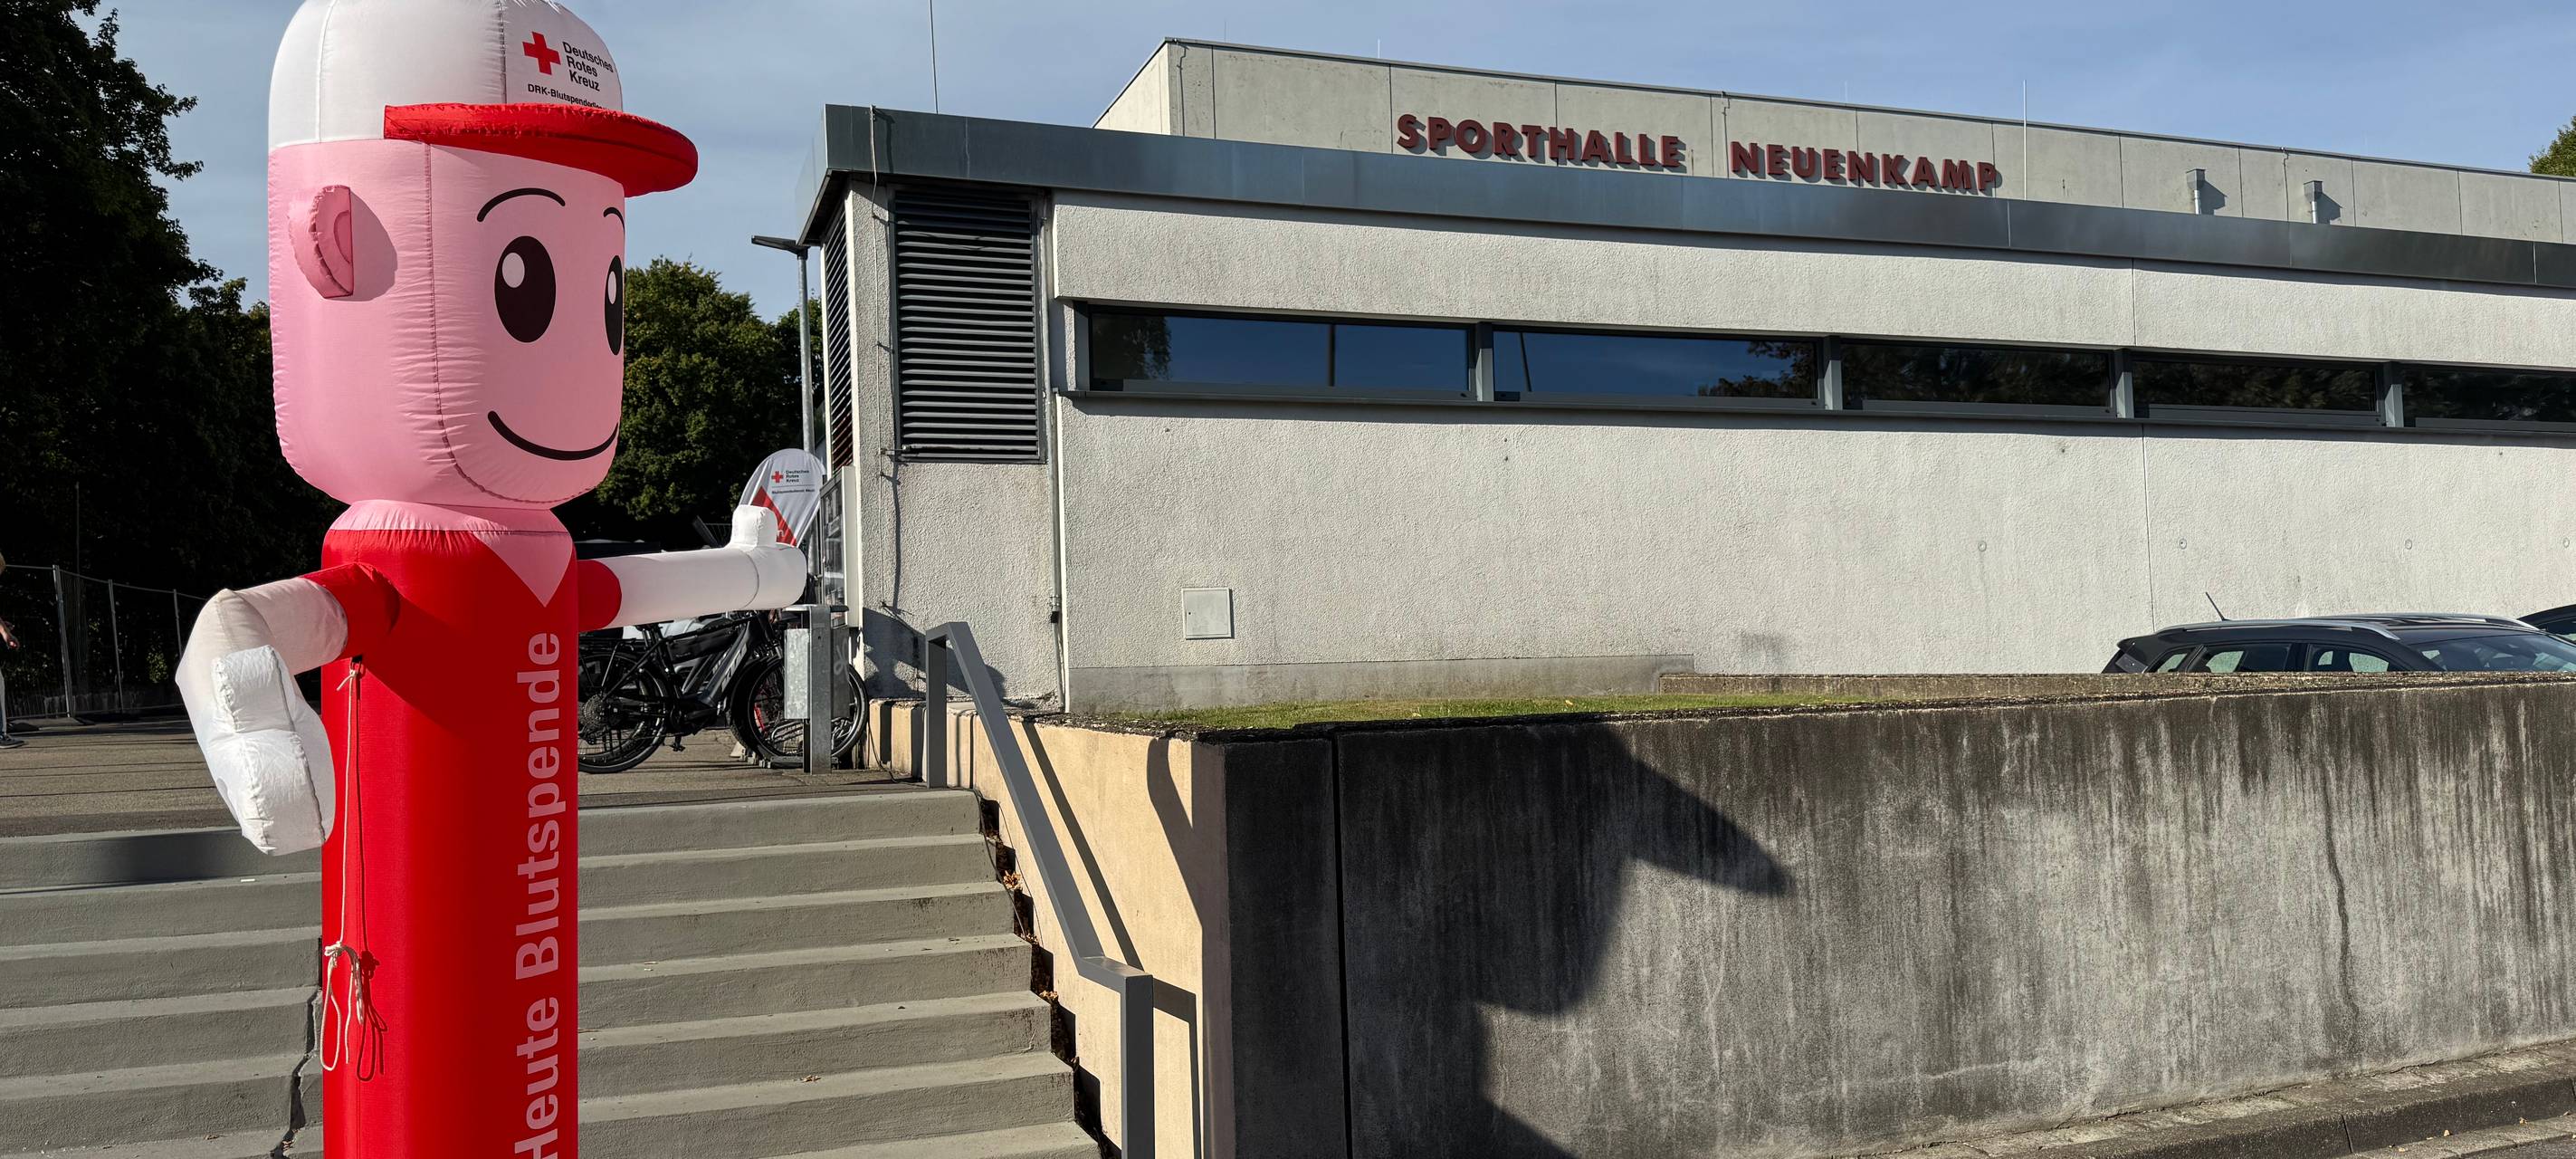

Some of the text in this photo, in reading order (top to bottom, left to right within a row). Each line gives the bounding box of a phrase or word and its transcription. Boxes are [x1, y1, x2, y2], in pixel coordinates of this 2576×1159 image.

[562, 41, 614, 72] Deutsches
[566, 54, 598, 77] Rotes
[568, 69, 600, 91] Kreuz
[1397, 113, 1997, 190] SPORTHALLE NEUENKAMP
[514, 632, 566, 1159] Heute Blutspende
